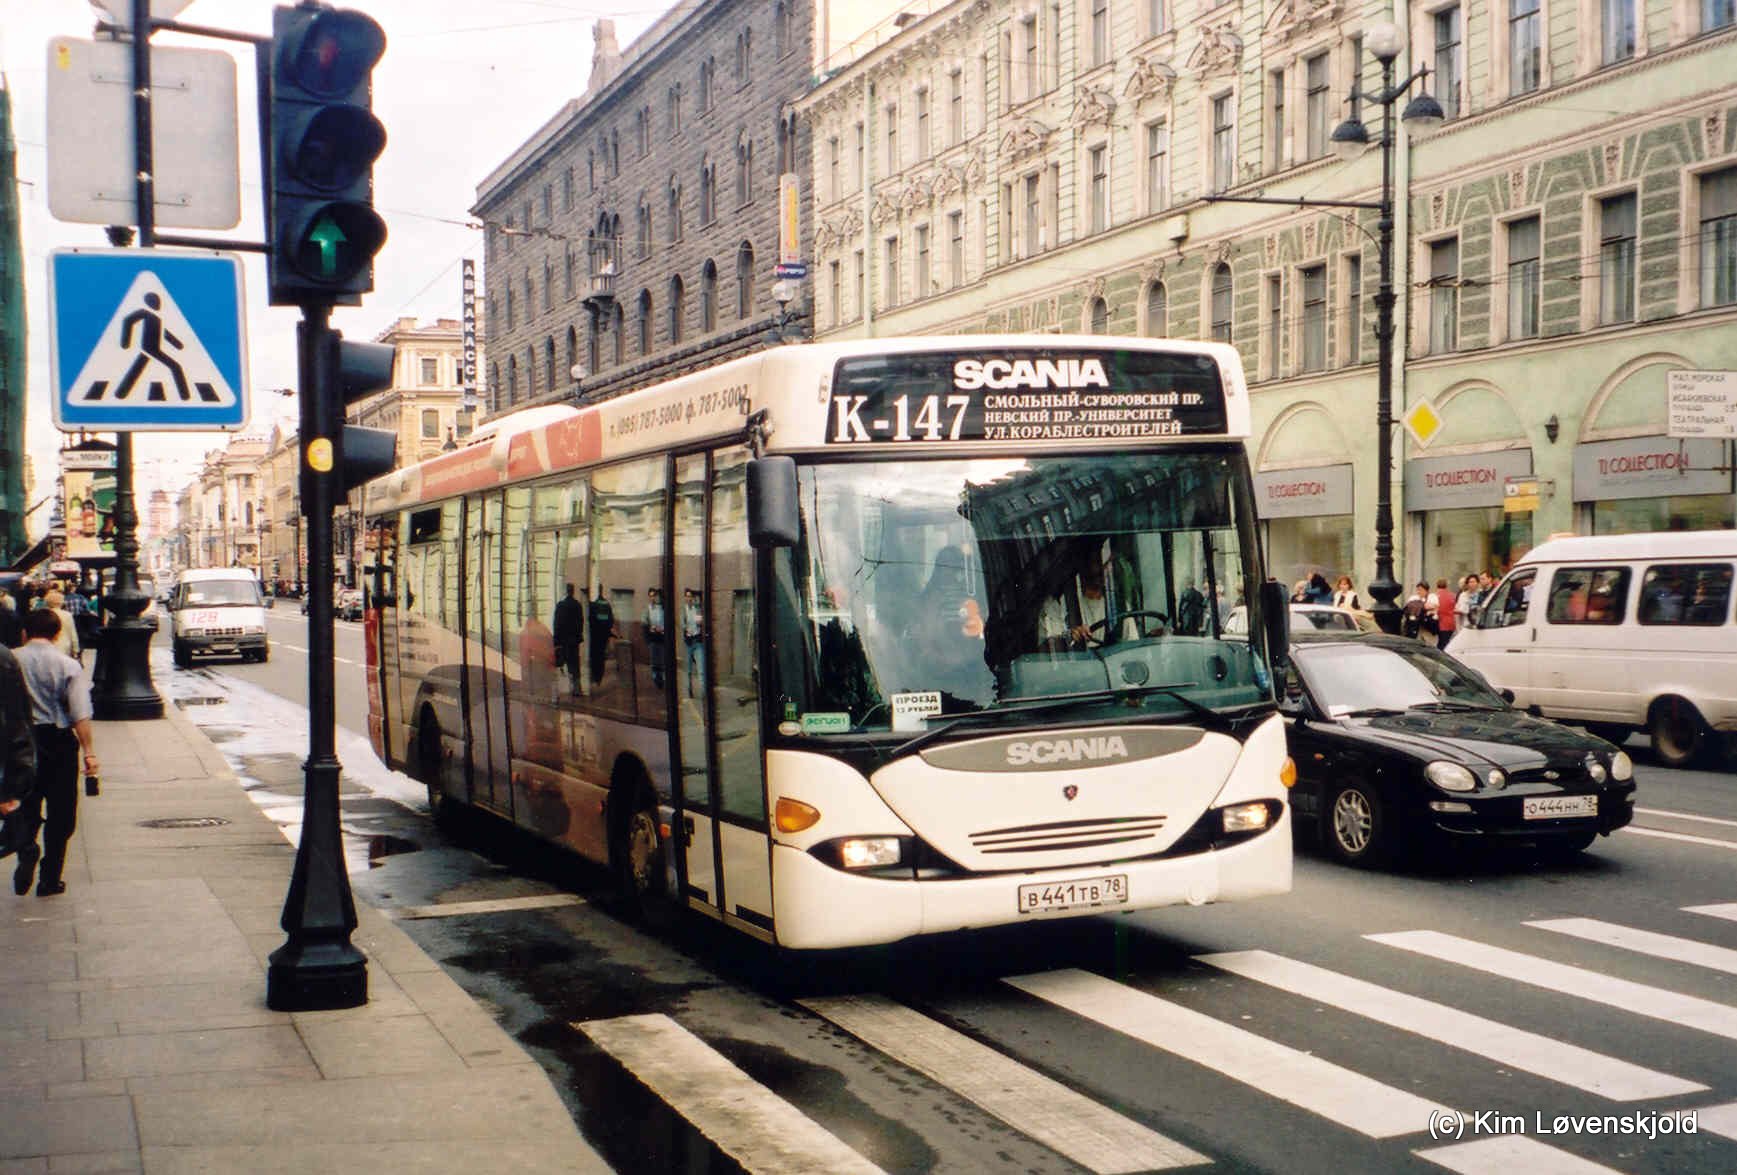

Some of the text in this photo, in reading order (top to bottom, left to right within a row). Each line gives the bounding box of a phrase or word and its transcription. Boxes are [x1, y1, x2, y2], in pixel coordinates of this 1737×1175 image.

[954, 359, 1108, 389] SCANIA
[984, 392, 1205, 409] СМОЛЬНЫЙ-СУВОРОВСКИЙ ПР.
[833, 394, 970, 442] К-147
[984, 411, 1049, 424] НЕВСКИЙ
[1609, 453, 1688, 473] COLLECTION
[1434, 468, 1497, 486] COLLECTION
[1275, 482, 1326, 498] COLLECTION
[896, 695, 938, 704] ПРОЕЗД
[1006, 735, 1128, 766] SCANIA
